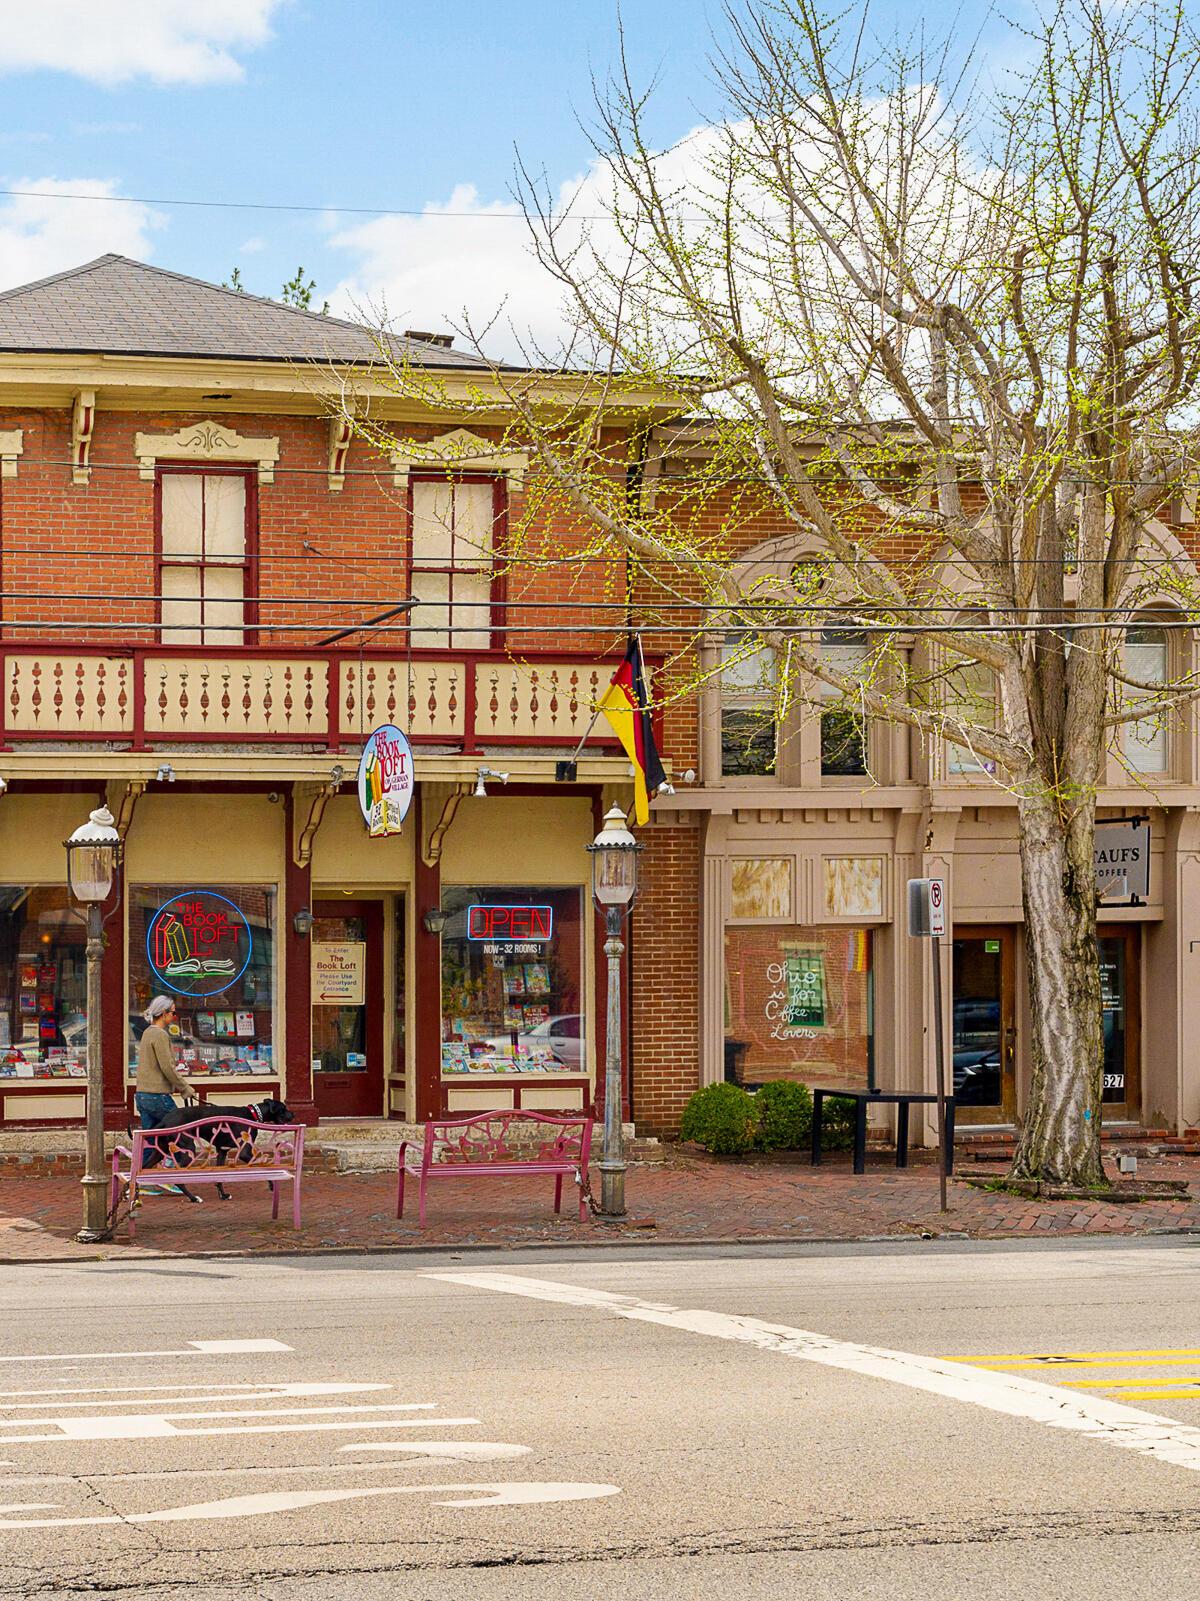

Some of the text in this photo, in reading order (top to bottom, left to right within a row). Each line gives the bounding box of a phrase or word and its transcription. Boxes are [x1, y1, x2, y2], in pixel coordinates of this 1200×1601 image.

[374, 731, 387, 746] THE
[376, 740, 400, 761] BOOK
[380, 754, 406, 793] LOFT
[176, 902, 203, 913] THE
[183, 913, 228, 926] BOOK
[470, 907, 551, 938] OPEN
[189, 925, 242, 957] LOFT
[340, 962, 357, 970] Loft
[766, 960, 817, 984] Ohio
[768, 985, 816, 1006] is for
[765, 1000, 809, 1023] Coffee
[770, 1023, 818, 1041] Lovers
[1103, 1075, 1123, 1087] 627
